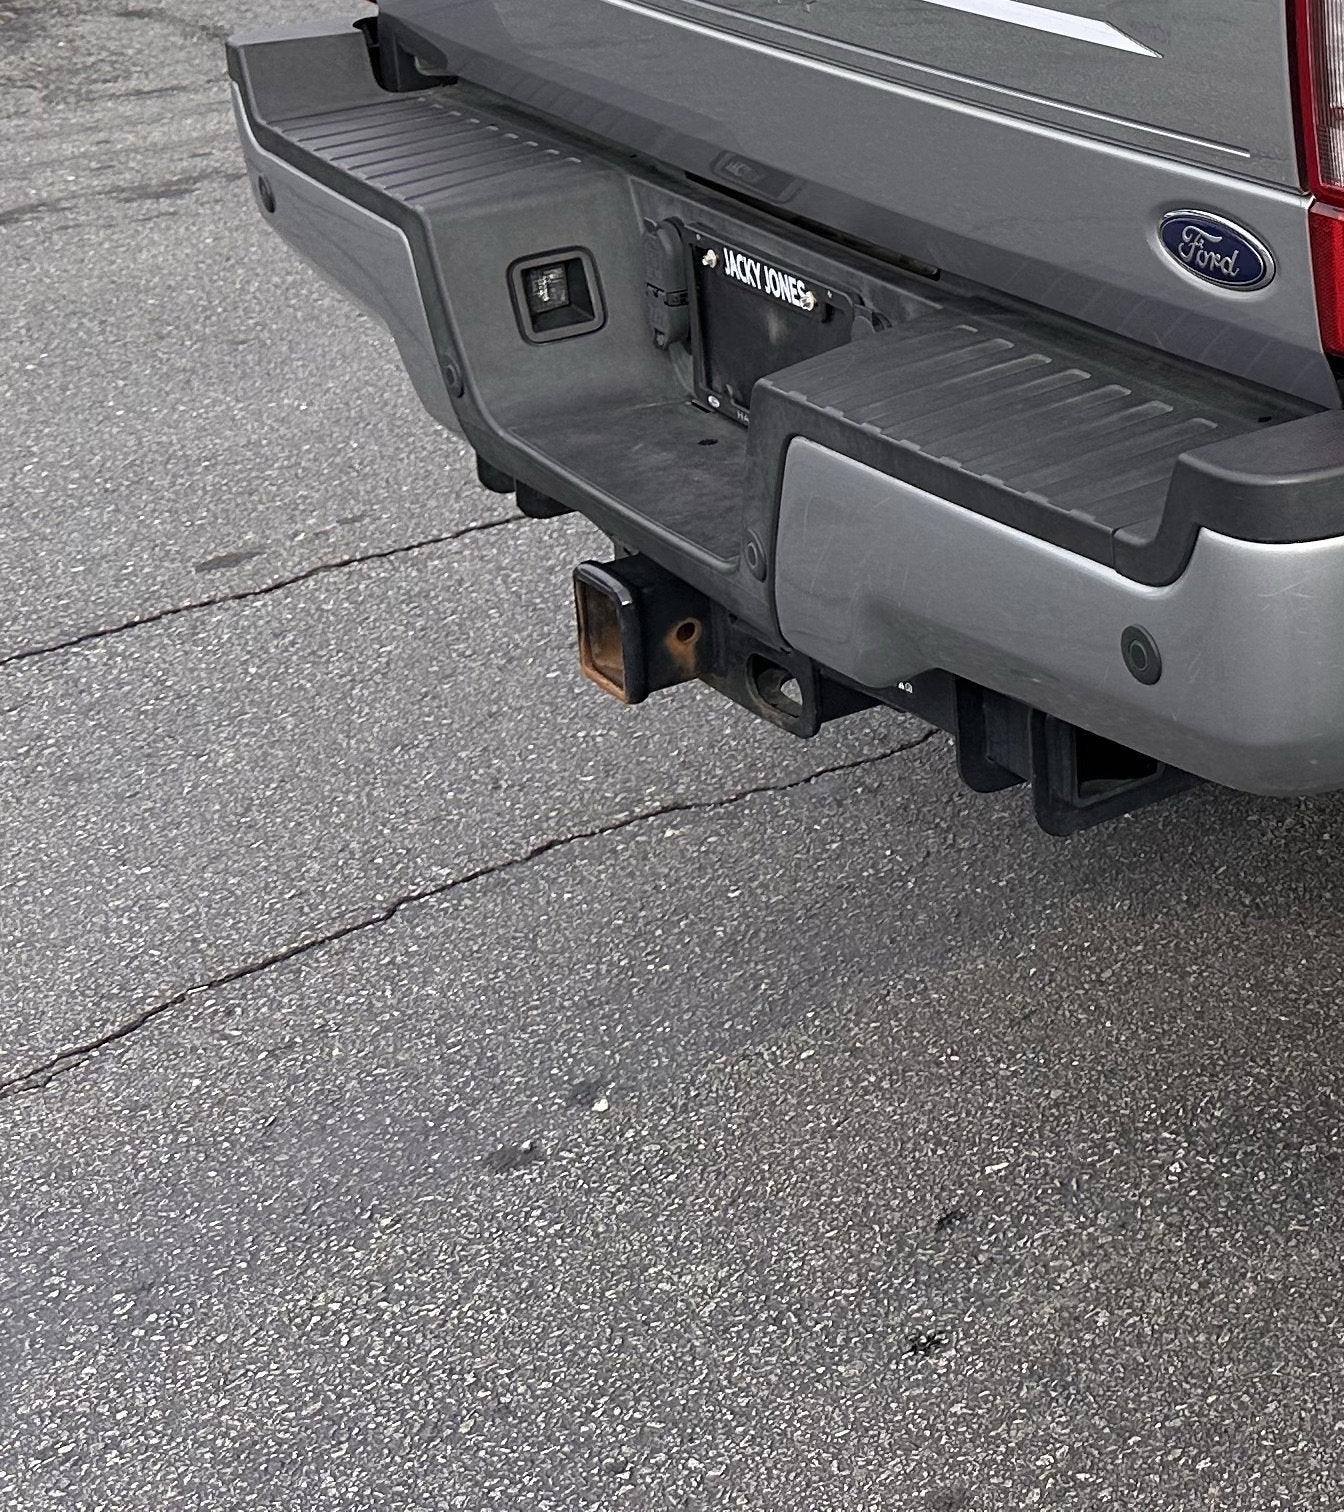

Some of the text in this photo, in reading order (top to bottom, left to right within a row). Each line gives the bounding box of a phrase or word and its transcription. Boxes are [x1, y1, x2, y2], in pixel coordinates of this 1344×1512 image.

[722, 247, 807, 309] JACKY JONES
[1178, 225, 1240, 277] Ford
